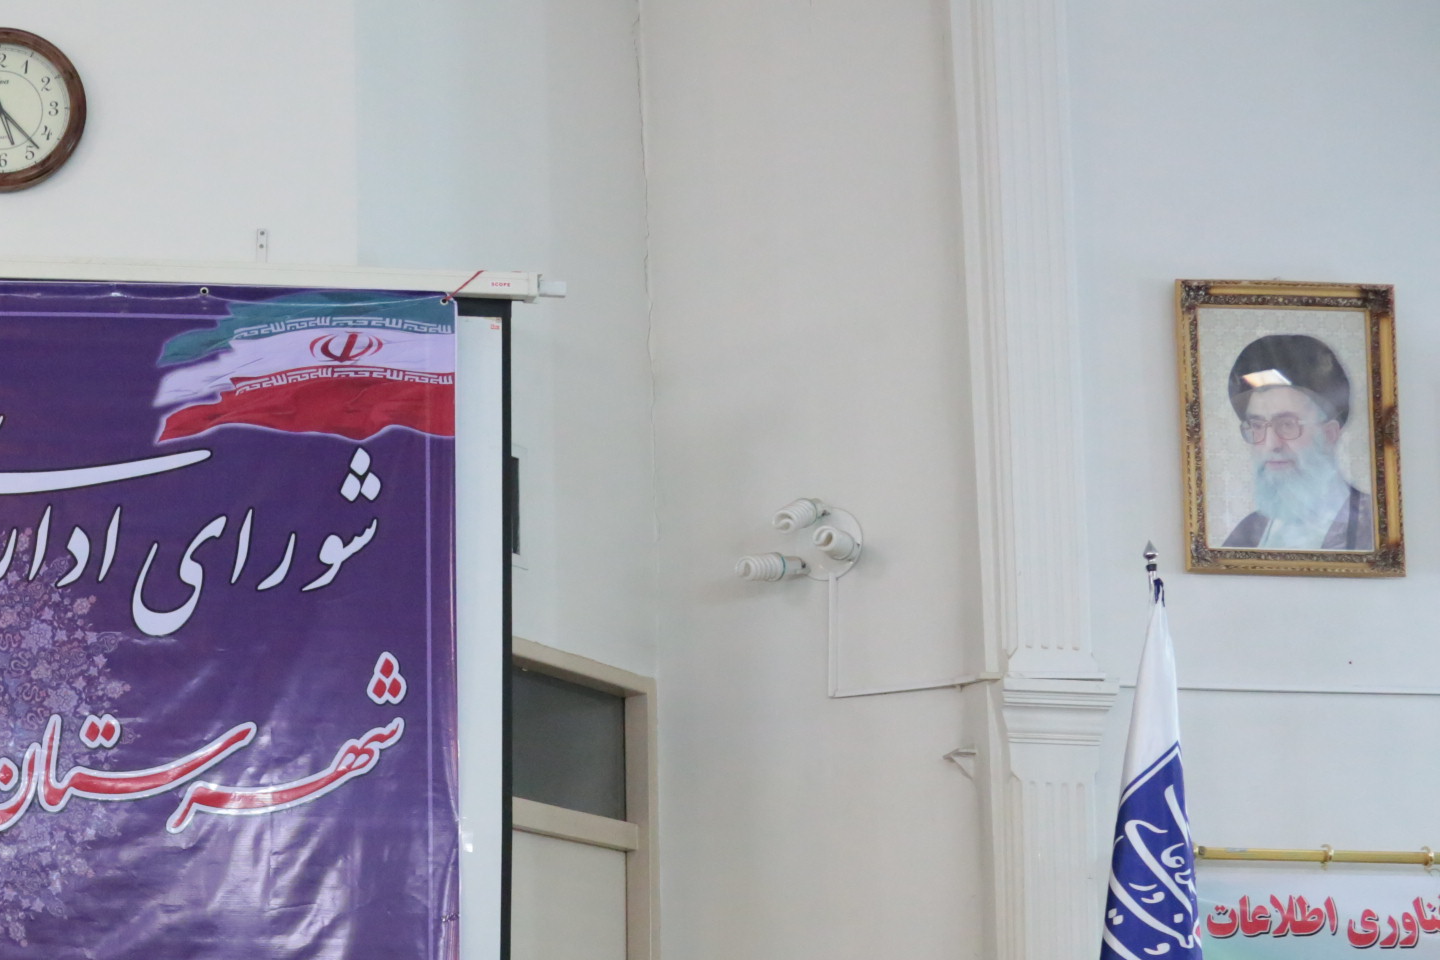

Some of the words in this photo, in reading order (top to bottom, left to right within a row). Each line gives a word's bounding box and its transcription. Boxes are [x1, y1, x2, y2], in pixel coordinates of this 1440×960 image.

[21, 59, 29, 75] 1
[40, 76, 51, 92] 2
[48, 101, 59, 116] 3
[40, 126, 53, 141] 4
[24, 145, 36, 161] 5
[132, 447, 383, 637] شورای
[1206, 894, 1338, 938] اطلاعات
[1347, 894, 1440, 948] ناوری
